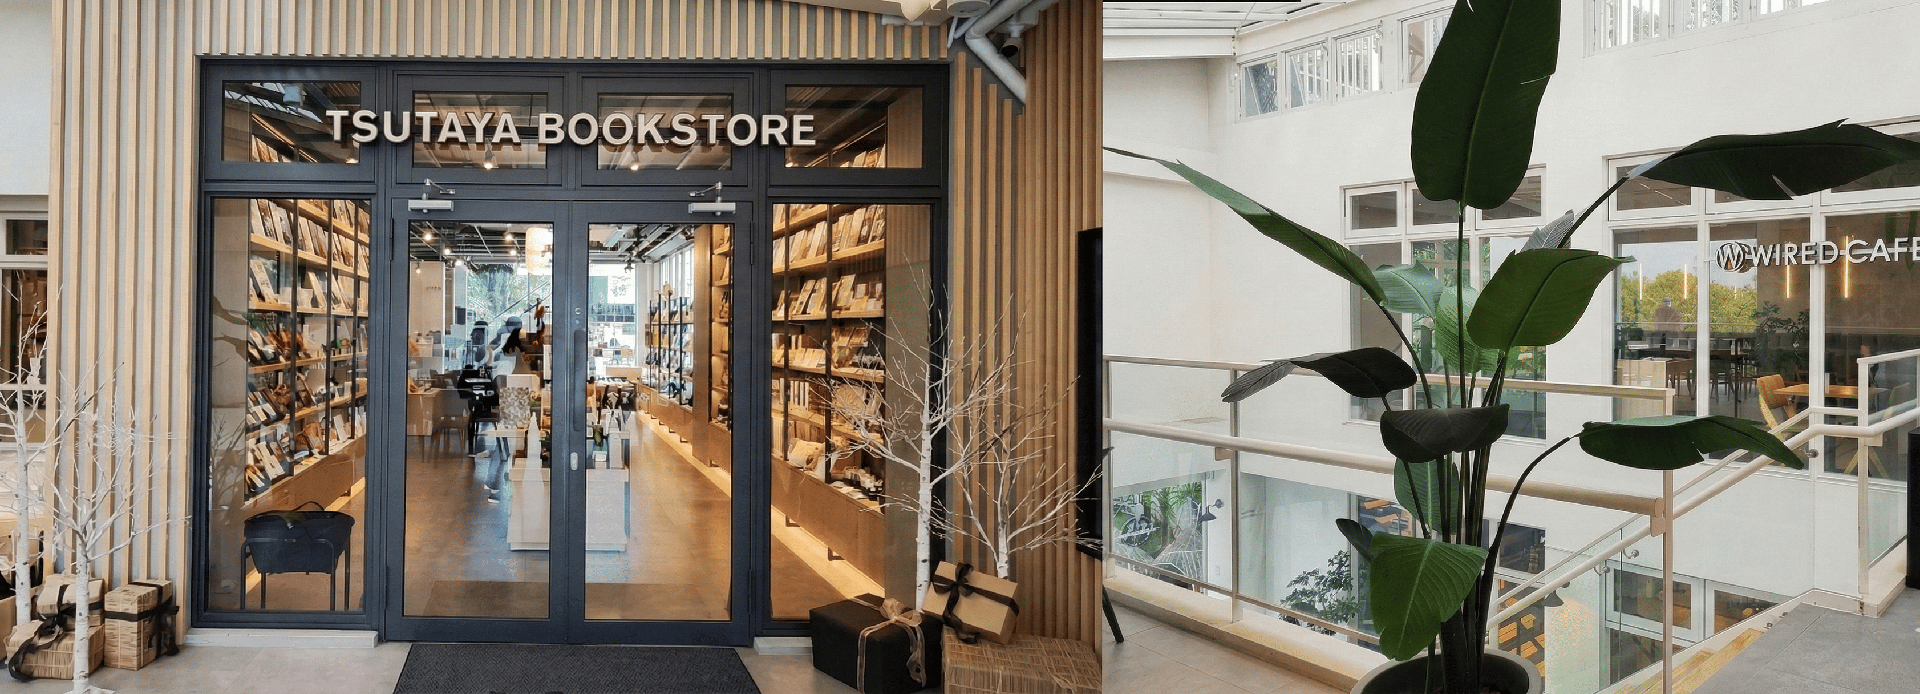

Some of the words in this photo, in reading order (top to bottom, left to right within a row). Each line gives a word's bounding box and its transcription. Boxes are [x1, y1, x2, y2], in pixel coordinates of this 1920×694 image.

[325, 109, 521, 144] TSUTAYA
[538, 112, 816, 147] BOOKSTORE
[1751, 240, 1839, 267] WIRED
